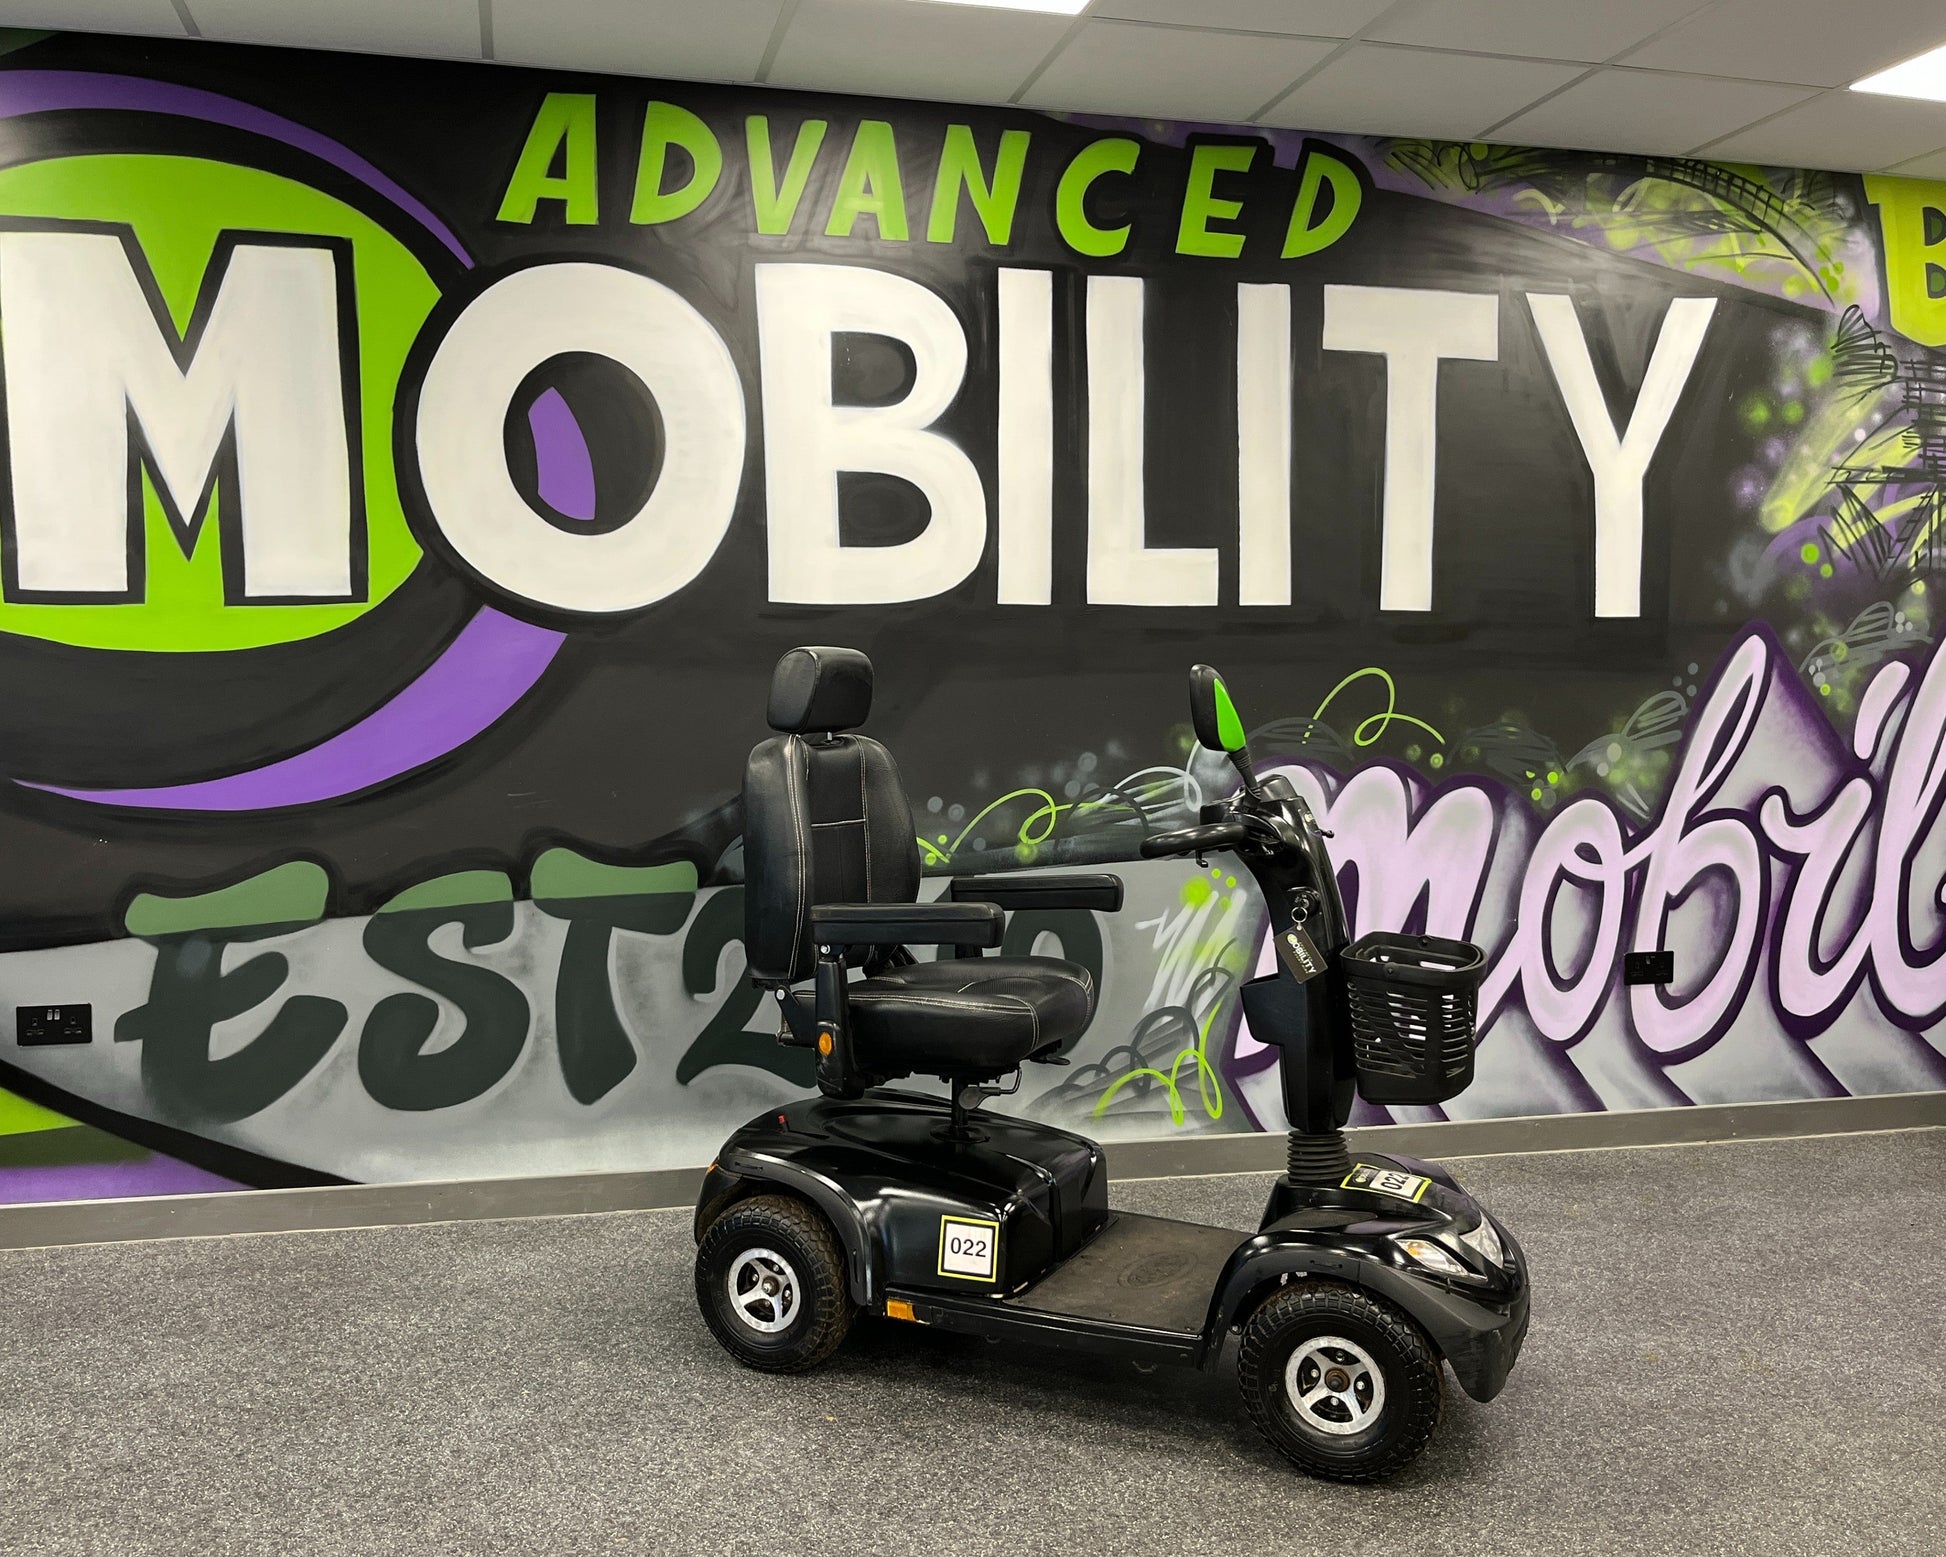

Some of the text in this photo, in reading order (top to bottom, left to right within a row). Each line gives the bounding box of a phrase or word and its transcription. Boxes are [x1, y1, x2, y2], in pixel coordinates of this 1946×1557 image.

[496, 93, 1363, 259] ADVANCED
[0, 232, 1718, 618] MOBILITY
[950, 1237, 987, 1258] 022
